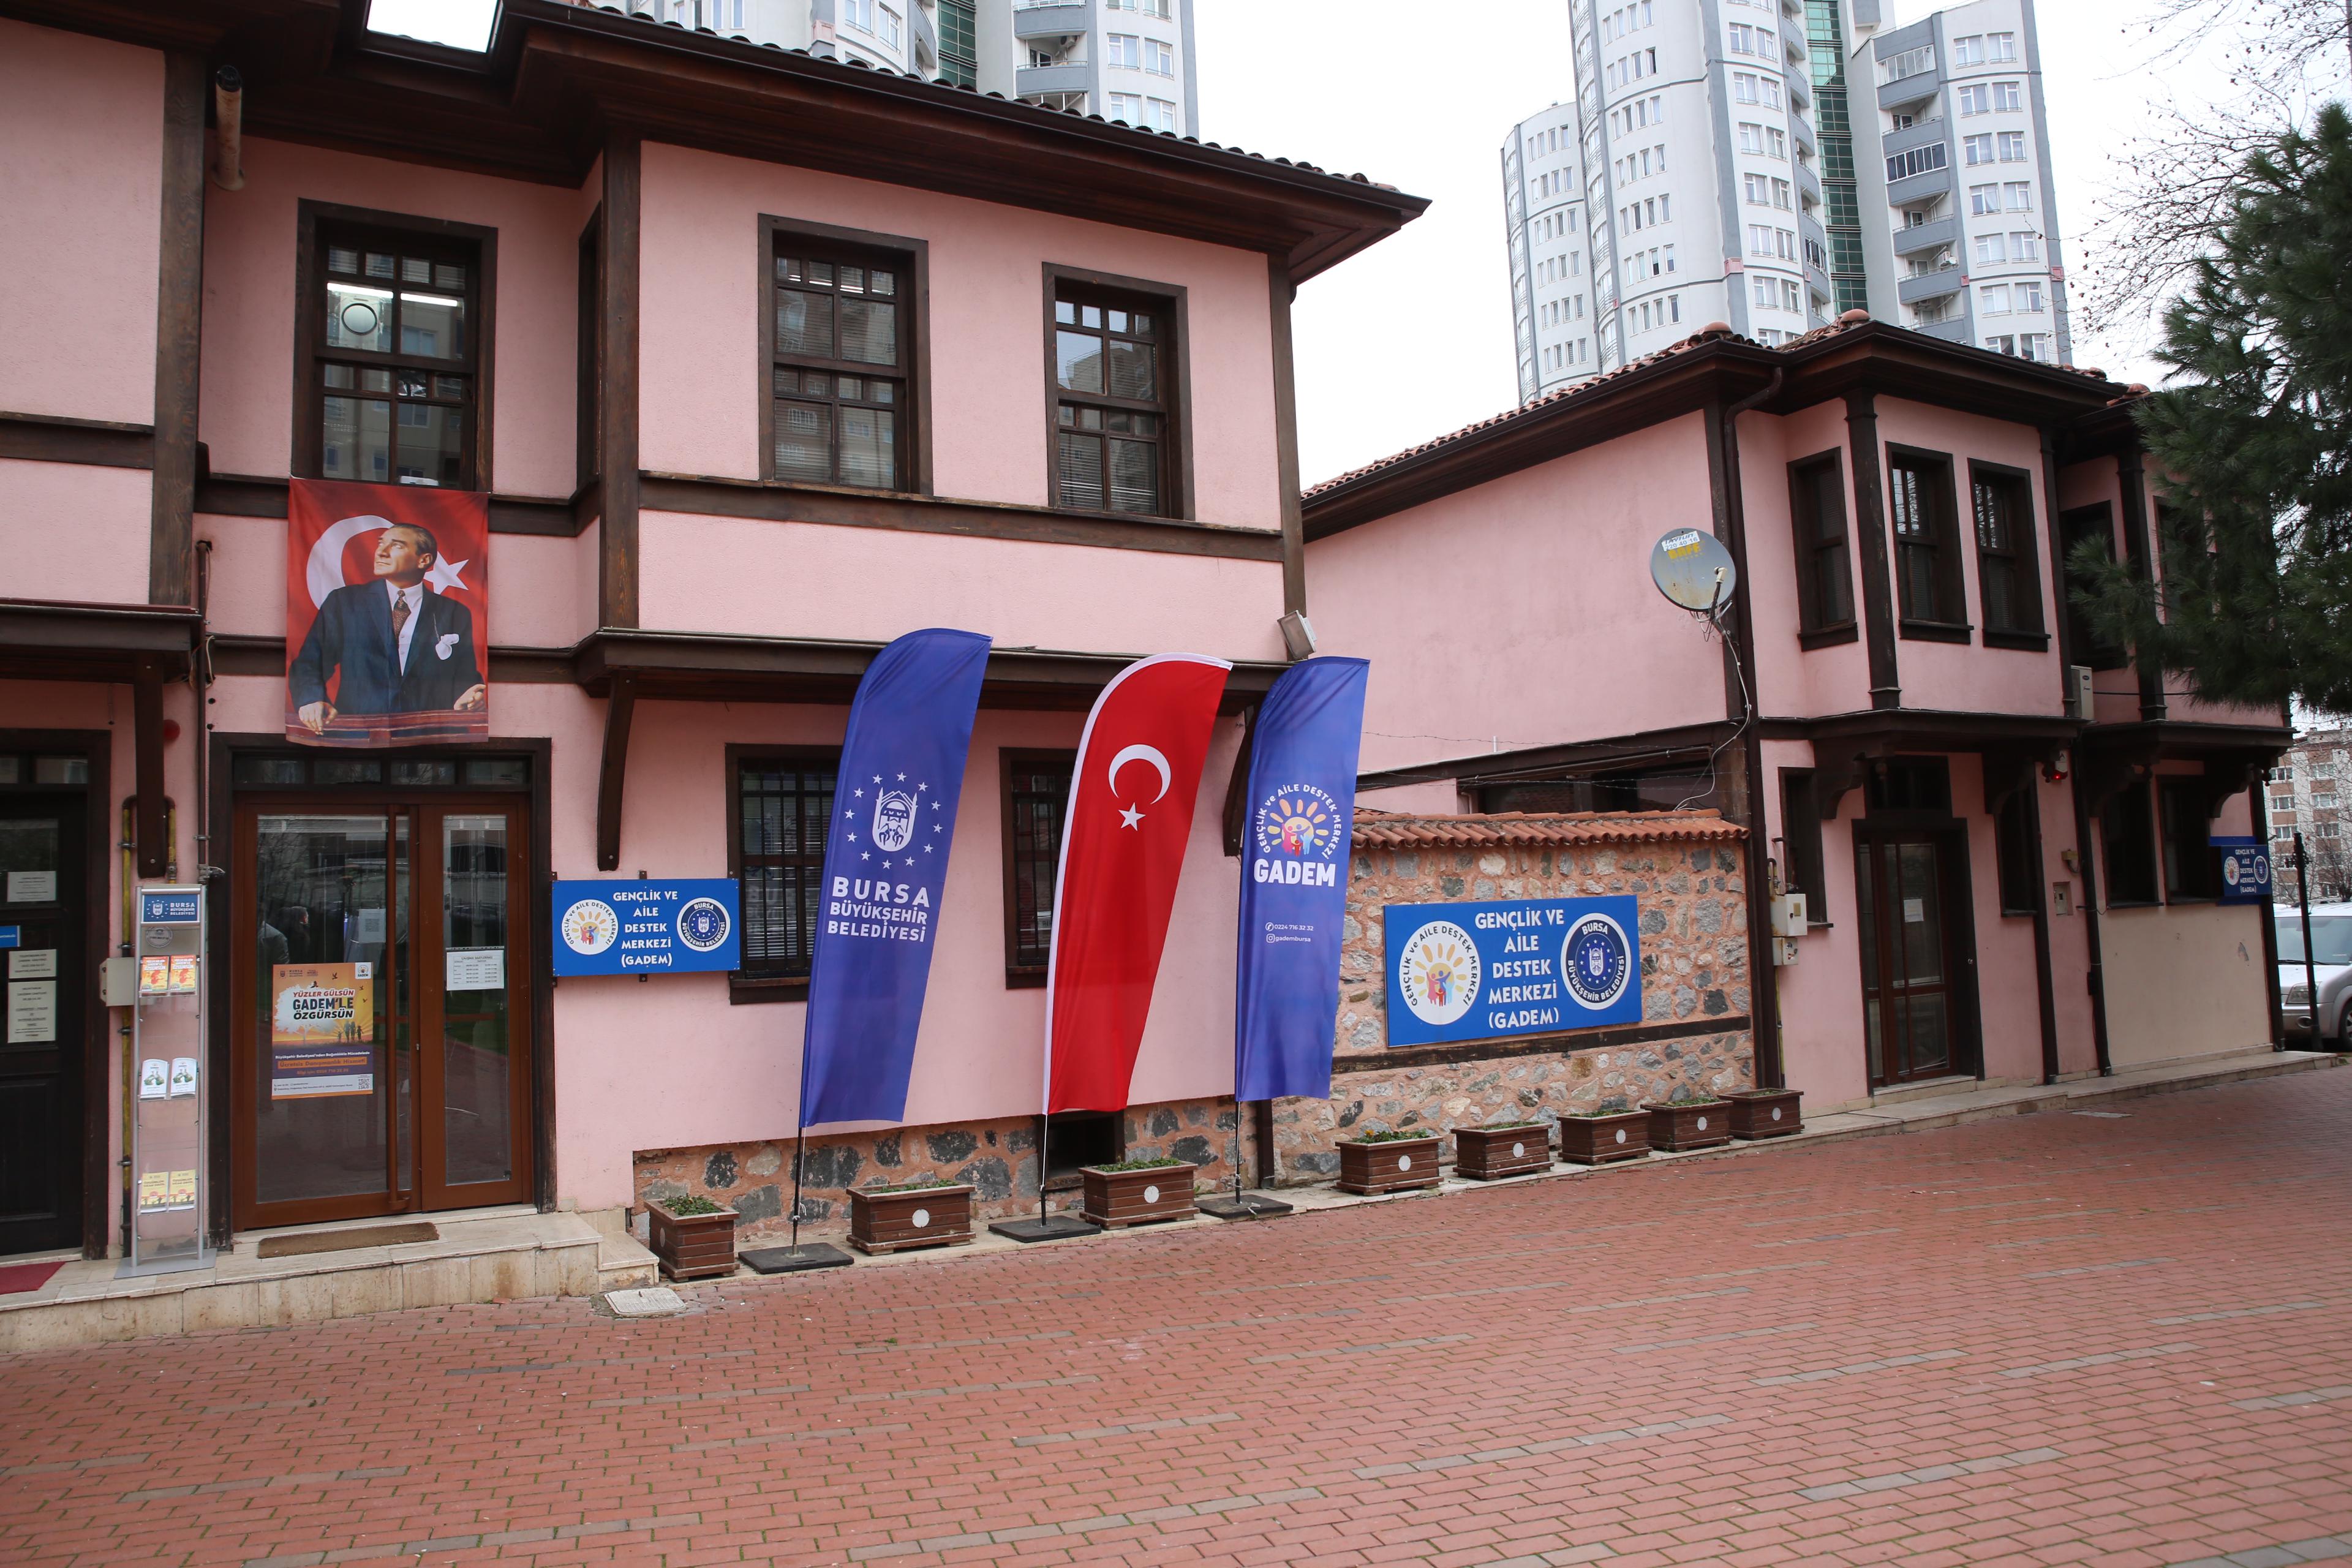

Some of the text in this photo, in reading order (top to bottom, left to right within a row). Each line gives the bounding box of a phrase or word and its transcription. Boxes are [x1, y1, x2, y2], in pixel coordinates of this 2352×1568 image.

[1256, 783, 1341, 859] GENÇLİK ve AİLE DESTEK MERKEZİ
[1254, 858, 1336, 887] GADEM
[613, 889, 677, 902] GENÇLİK VE
[832, 876, 930, 907] BURSA
[633, 905, 659, 917] AİLE
[830, 900, 927, 924] BÜYÜKŞEHİR
[1475, 907, 1564, 930] GENÇLİK VE
[564, 918, 575, 945] GENÇLİK
[576, 902, 590, 911] AİLE
[591, 902, 613, 918] DESTEK
[605, 918, 616, 945] MERKEZİ
[624, 923, 667, 933] DESTEK
[682, 922, 725, 947] BÜYÜKŞEHİR BELEDİYESİ
[827, 919, 926, 942] BELEDİYESİ
[1582, 923, 1608, 935] BURSA
[622, 937, 671, 949] MERKEZİ
[1504, 933, 1539, 953] AİLE
[621, 953, 673, 967] (GADEM)
[1404, 925, 1478, 1006] GENÇLİK ve AİLE DESTEK MERKEZİ
[1492, 959, 1551, 978] DESTEK
[1567, 956, 1624, 1001] BÜYÜKŞEHİR BELEDİYESİ
[1488, 979, 1557, 1005] MERKEZİ
[293, 998, 353, 1010] GADEM'LE
[293, 1009, 353, 1020] ÖZGÜRSÜN
[1488, 1008, 1559, 1029] (GADEM)
